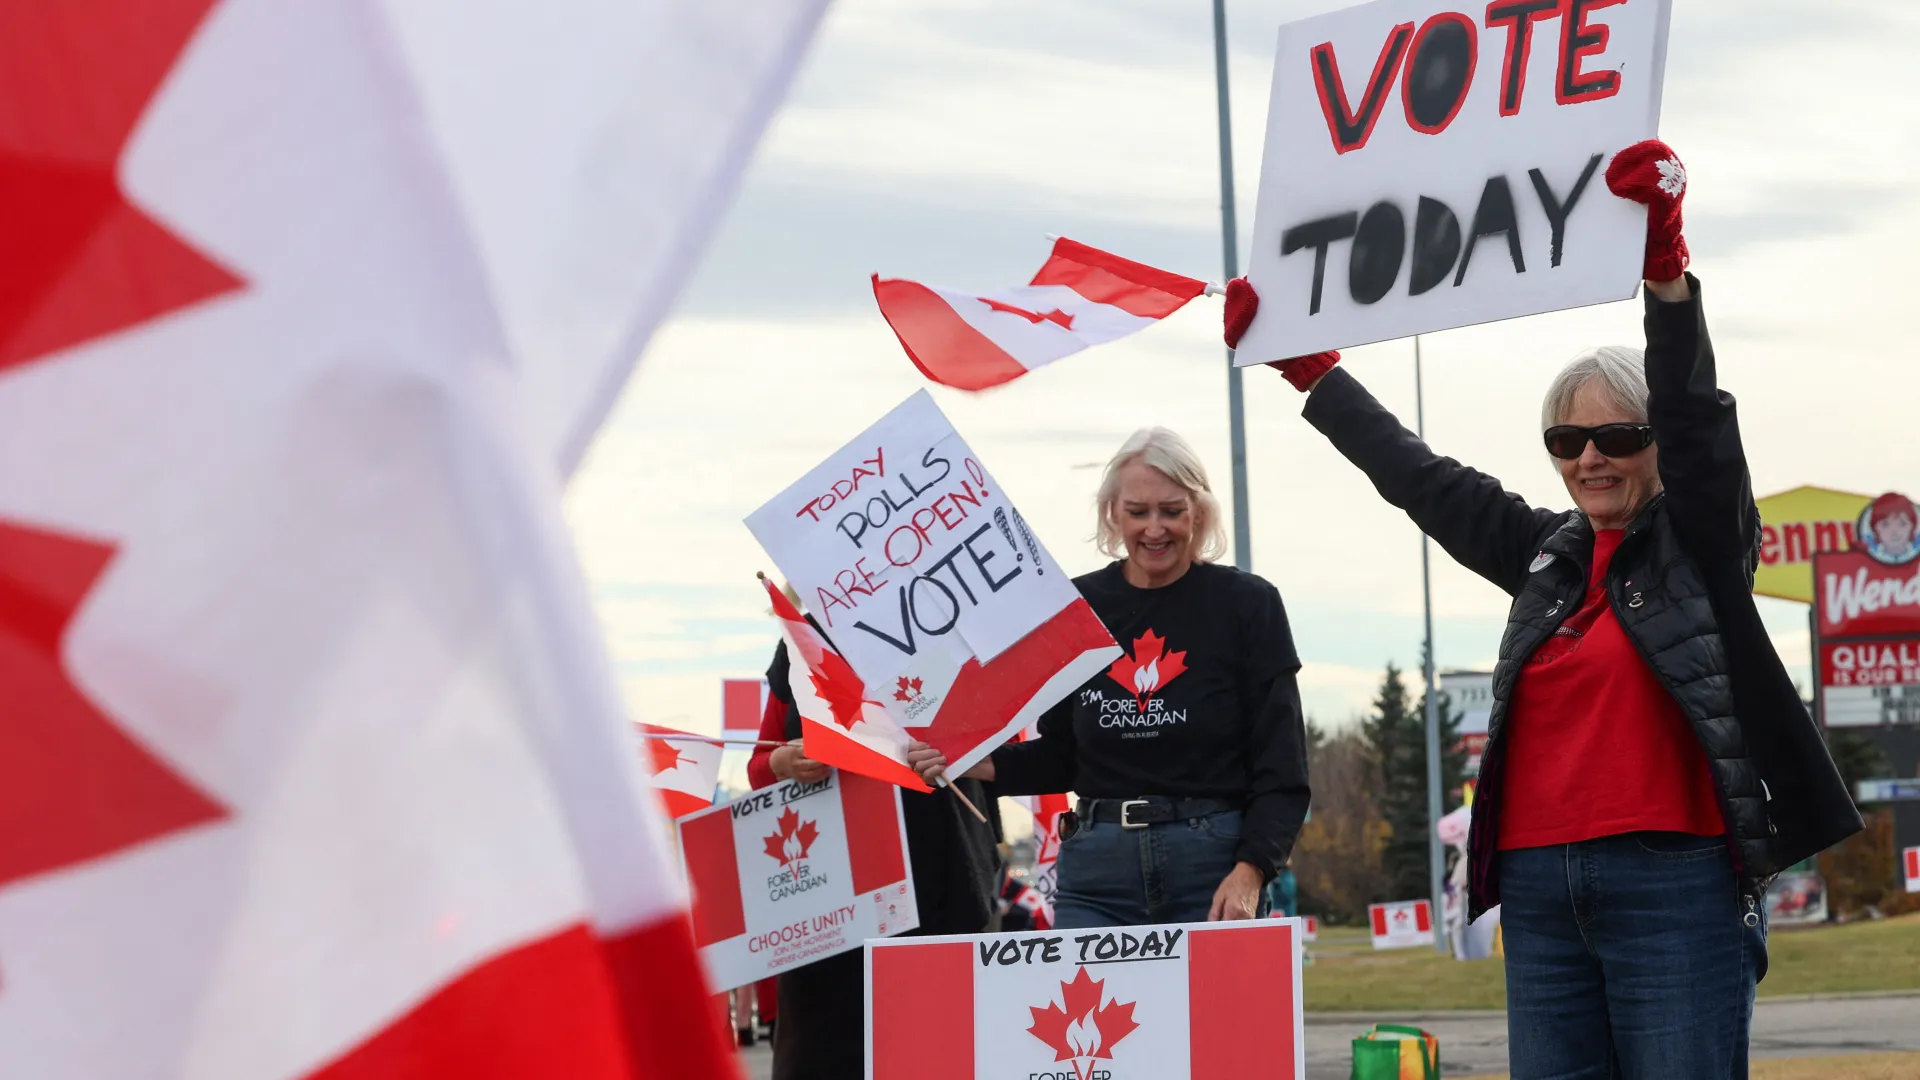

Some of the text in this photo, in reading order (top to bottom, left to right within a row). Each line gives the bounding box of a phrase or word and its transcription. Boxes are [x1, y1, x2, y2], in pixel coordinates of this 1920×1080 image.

[1310, 0, 1626, 155] VOTE
[1280, 152, 1605, 317] TODAY
[796, 447, 886, 522] TODAY
[836, 447, 951, 549] POLLS
[816, 457, 989, 628] ARE OPEN!
[852, 506, 1045, 656] VOTE!!
[1099, 708, 1187, 728] CANADIAN
[1100, 692, 1164, 714] FOREVER
[731, 790, 774, 819] VOTE
[767, 861, 811, 888] FOREVER
[769, 873, 828, 902] CANADIAN
[748, 904, 856, 953] CHOOSE UNITY
[980, 929, 1184, 966] VOTE TODAY
